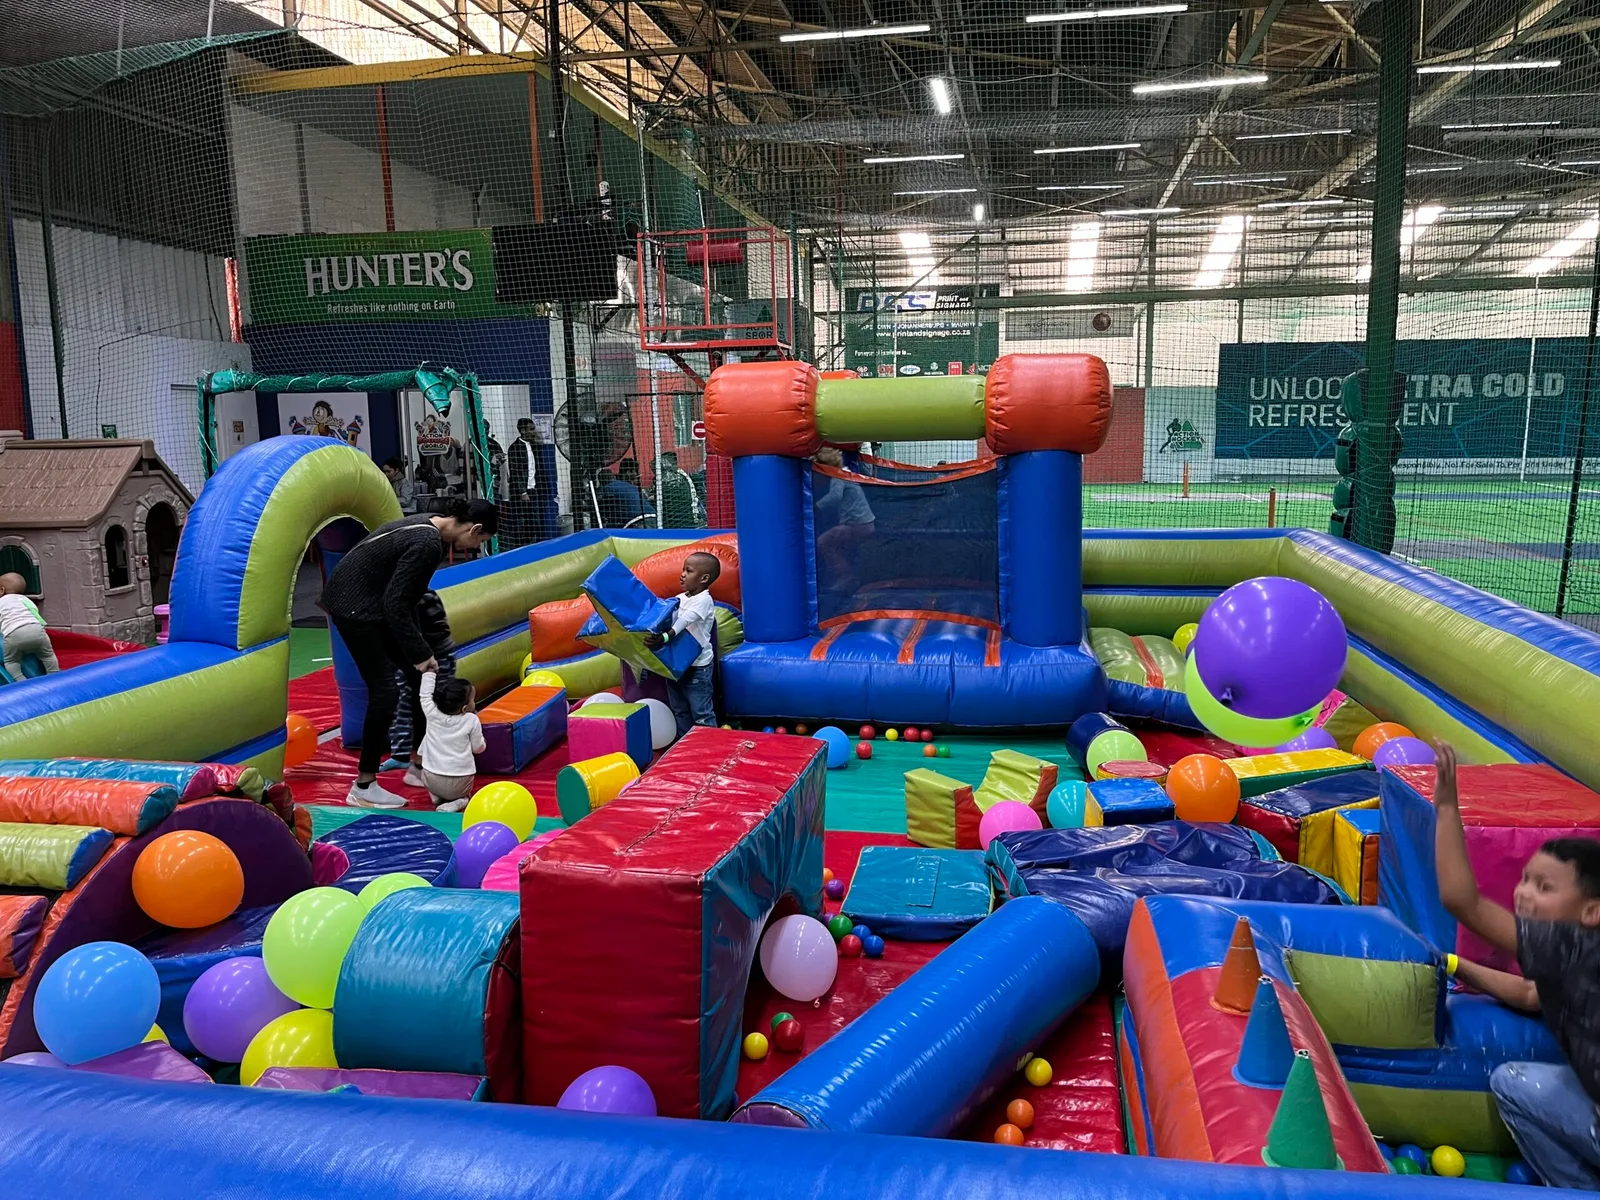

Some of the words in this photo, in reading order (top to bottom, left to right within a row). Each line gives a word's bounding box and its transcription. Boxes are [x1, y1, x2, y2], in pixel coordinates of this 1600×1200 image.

[304, 248, 474, 297] HUNTER'S
[327, 303, 368, 314] Refreshes
[370, 302, 386, 313] like
[388, 300, 419, 313] nothing
[421, 301, 431, 310] on
[745, 331, 785, 339] SPORS
[1250, 377, 1342, 400] UNLOC
[1404, 375, 1473, 398] TRA
[1482, 373, 1564, 397] COLD
[1249, 402, 1459, 428] REFRESENT
